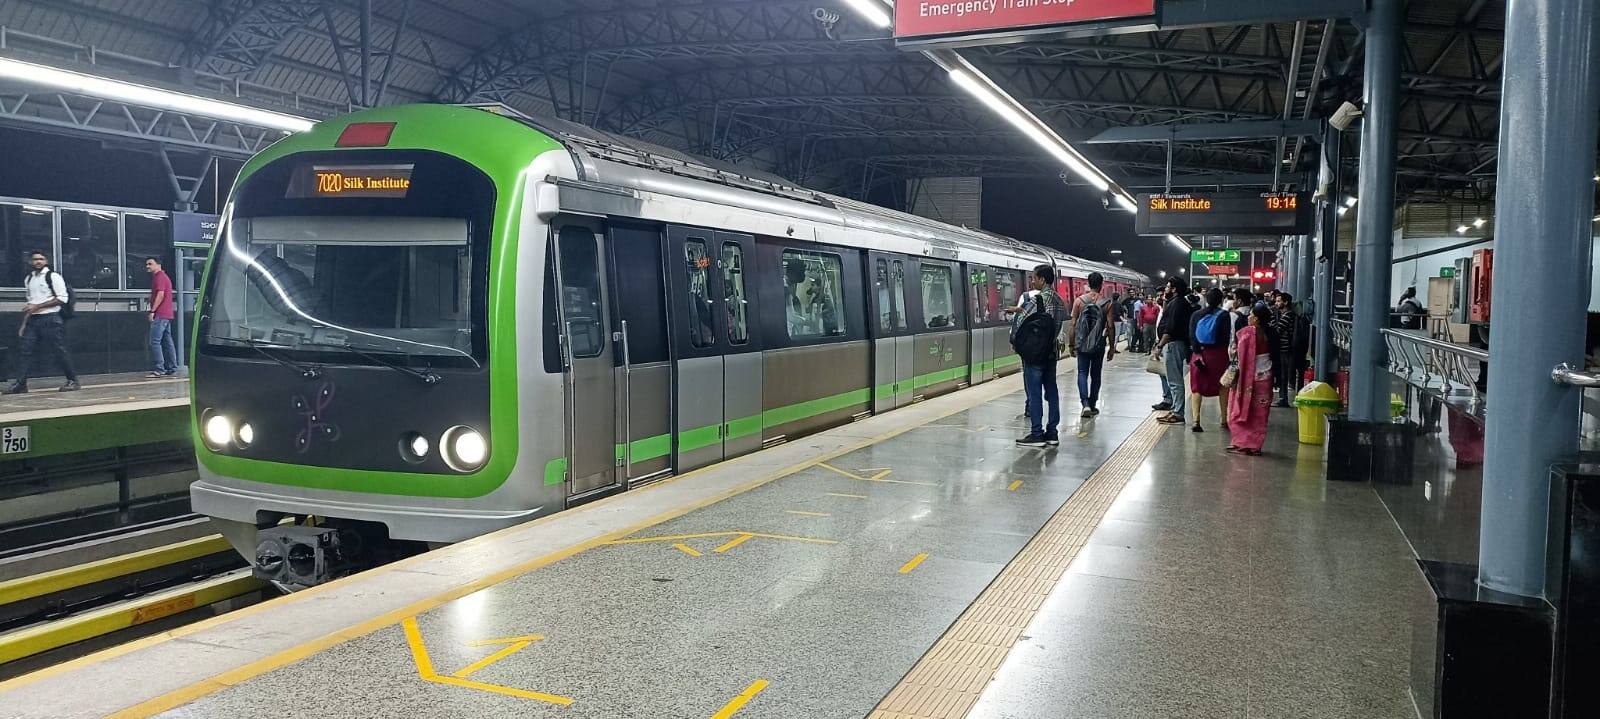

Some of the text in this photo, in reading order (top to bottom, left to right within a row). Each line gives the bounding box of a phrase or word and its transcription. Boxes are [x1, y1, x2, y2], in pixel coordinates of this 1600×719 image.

[920, 0, 997, 17] Emergency
[317, 173, 410, 192] 7020 Silk Institute
[1150, 198, 1211, 210] Silk Institute
[1267, 197, 1297, 210] 19:14
[4, 428, 12, 439] 3
[4, 437, 27, 453] 750
